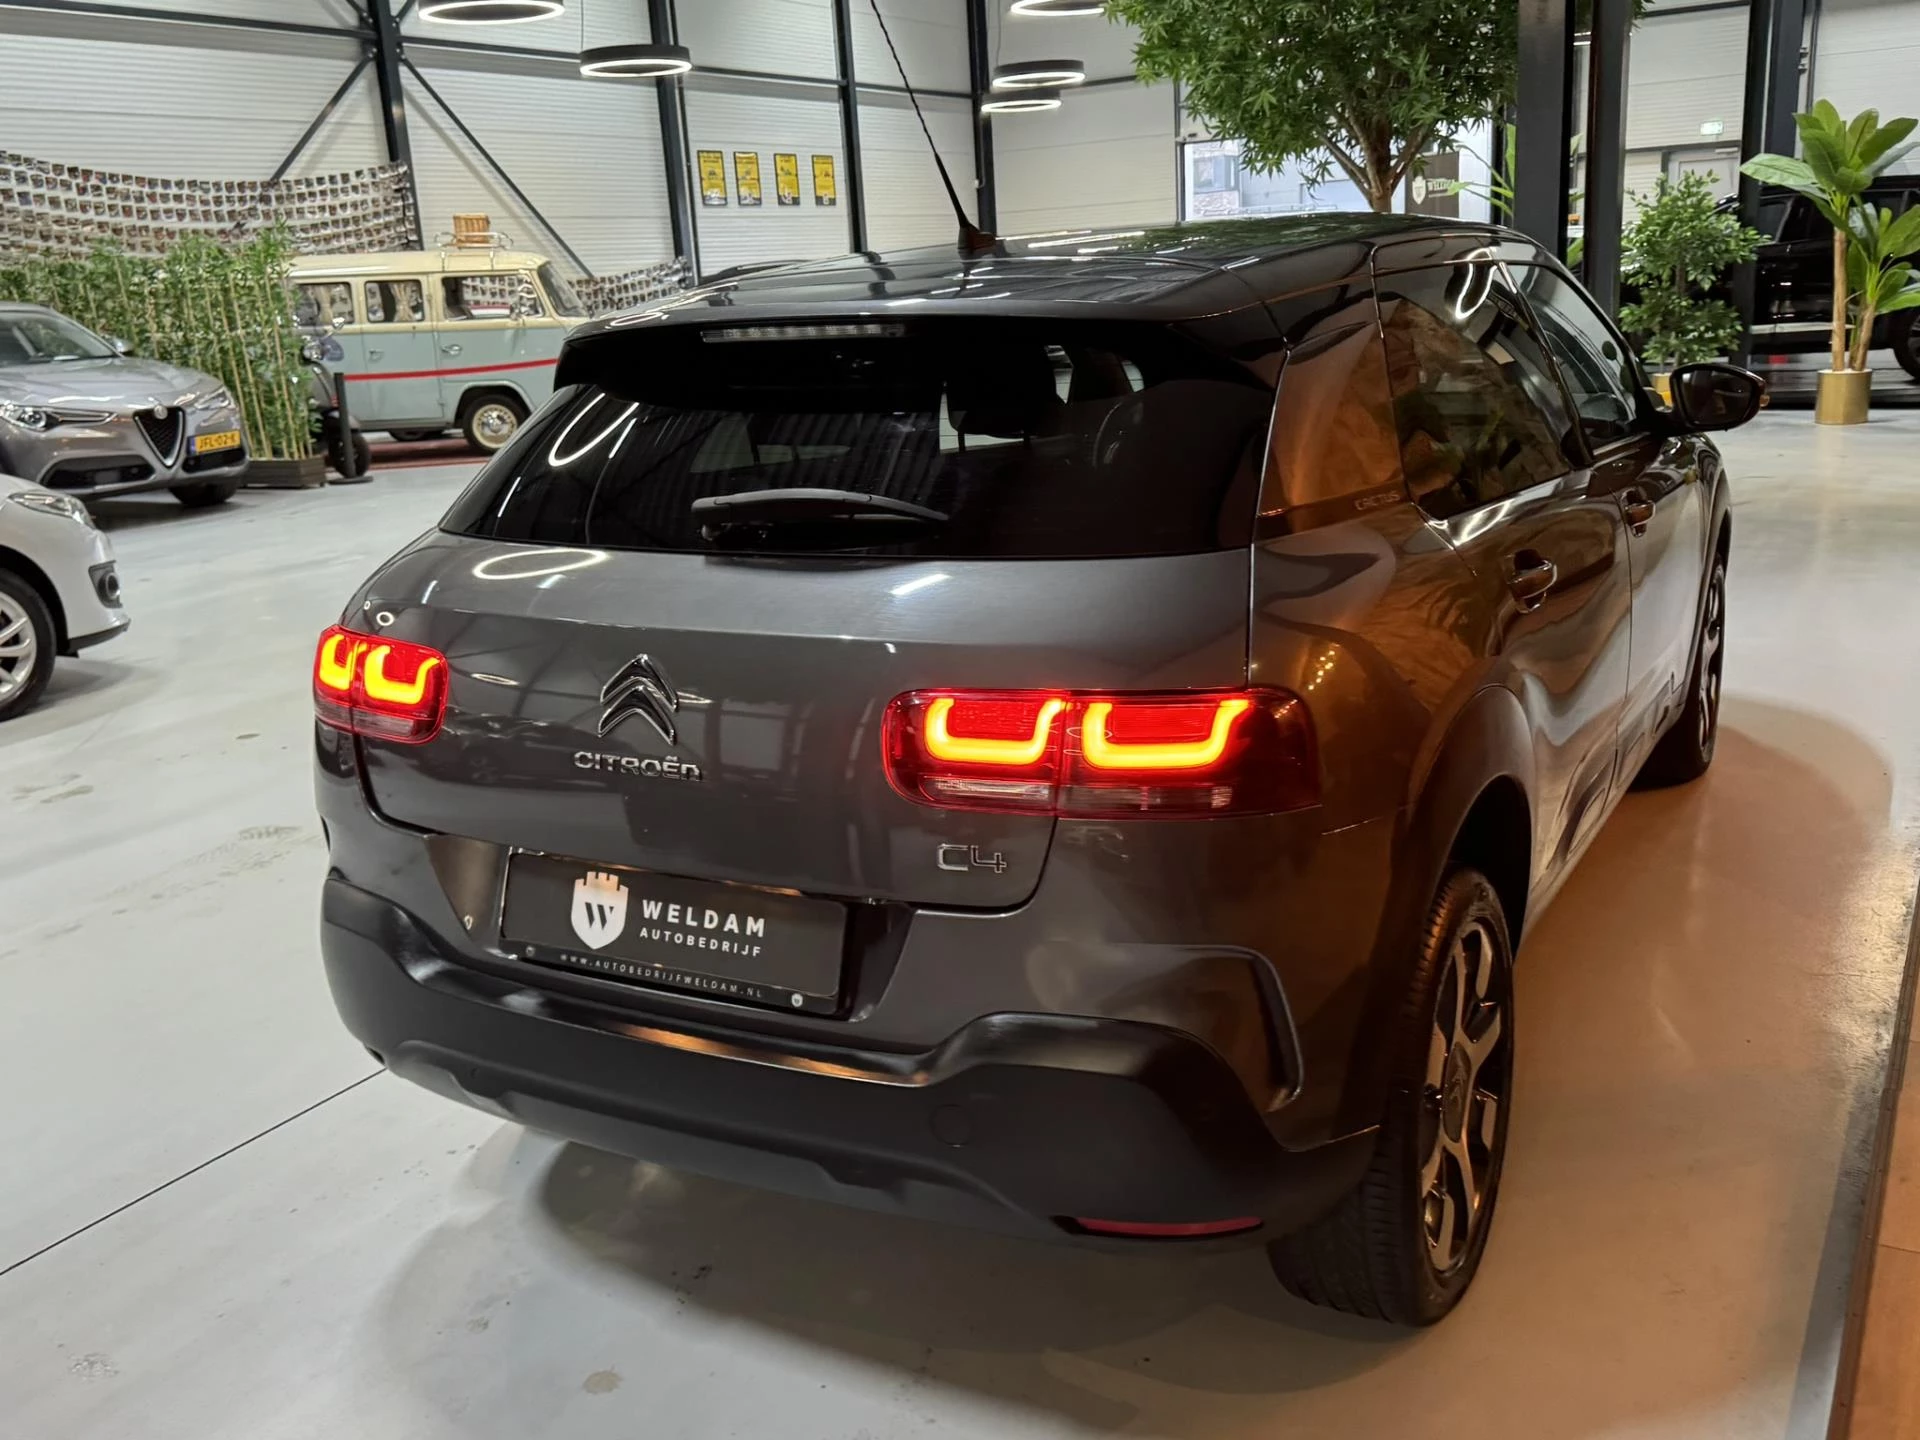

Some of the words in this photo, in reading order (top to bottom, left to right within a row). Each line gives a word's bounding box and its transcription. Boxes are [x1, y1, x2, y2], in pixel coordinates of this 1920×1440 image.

[937, 843, 1007, 874] C4
[584, 902, 614, 929] W
[642, 899, 766, 938] WELDAM
[640, 927, 761, 957] AUTOBEDRIJF
